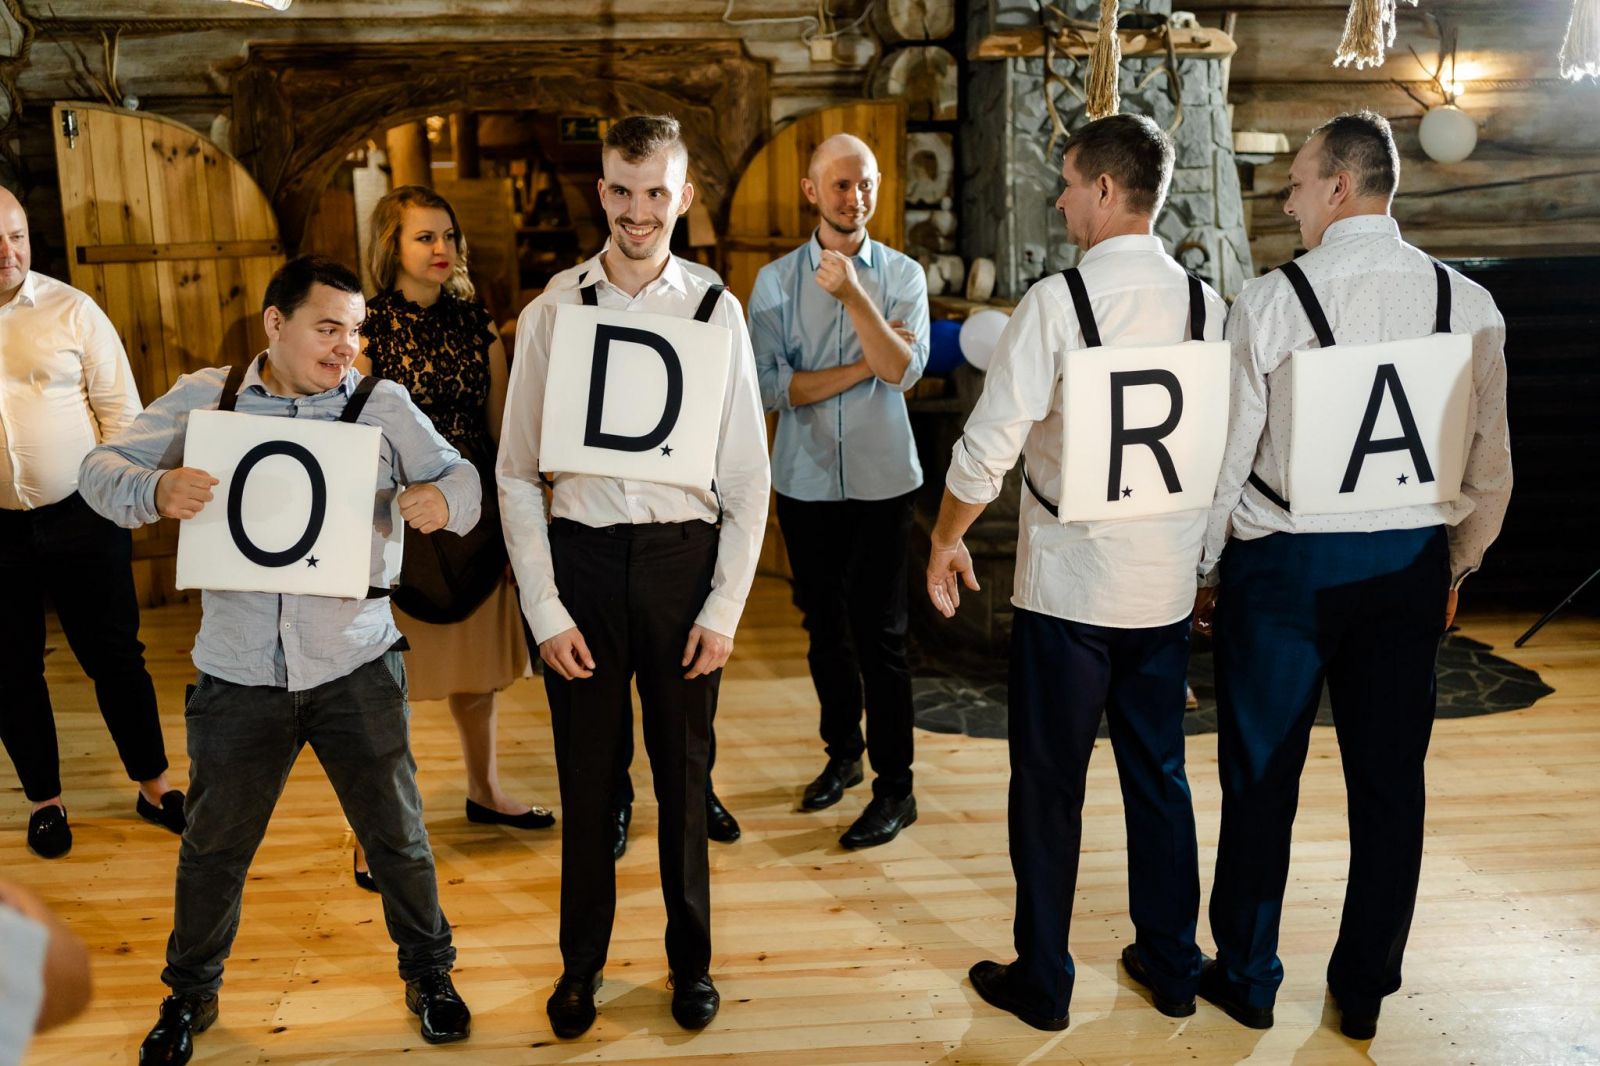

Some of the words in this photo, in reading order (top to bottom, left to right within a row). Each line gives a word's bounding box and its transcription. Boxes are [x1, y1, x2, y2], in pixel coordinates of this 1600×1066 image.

[584, 323, 684, 453] D
[1107, 368, 1184, 502] R
[1339, 363, 1435, 494] A
[227, 440, 327, 568] O
